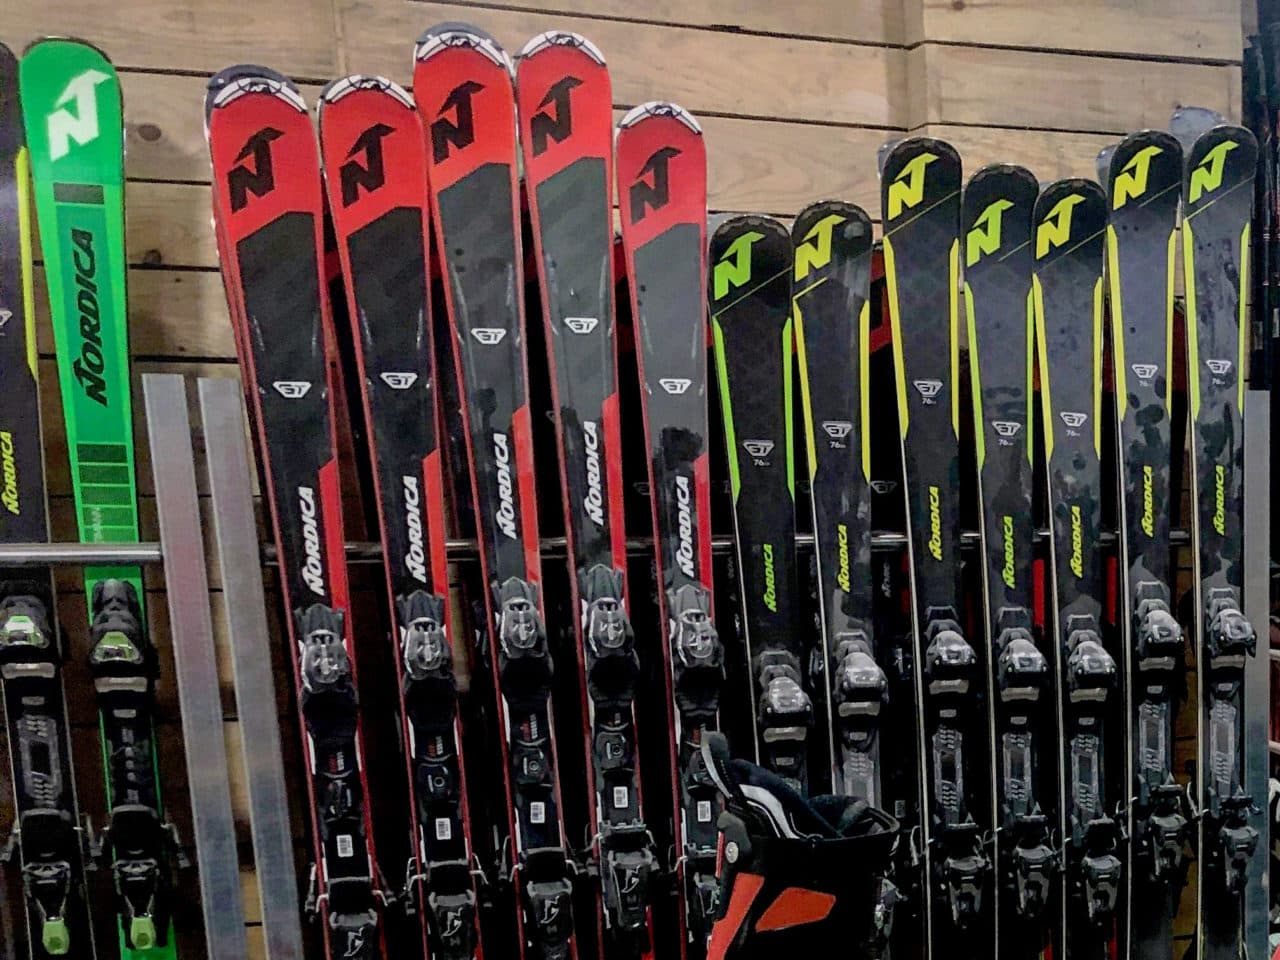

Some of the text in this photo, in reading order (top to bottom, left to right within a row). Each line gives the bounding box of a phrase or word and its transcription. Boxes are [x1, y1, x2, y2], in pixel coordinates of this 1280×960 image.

[73, 228, 108, 407] NORDICA
[0, 432, 20, 515] NORDICA
[493, 433, 517, 540] NORDICA
[585, 420, 605, 526] NORDICA
[1141, 466, 1154, 537] NORDICA
[1212, 465, 1226, 536] NORDICA
[301, 486, 325, 596] NORDICA
[404, 475, 426, 583] NORDICA
[676, 476, 694, 578] NORDICA
[836, 524, 850, 592] NORDICA
[928, 486, 942, 561] NORDICA
[1002, 516, 1016, 589] NORDICA
[1070, 505, 1083, 578] NORDICA
[764, 543, 777, 612] NORDICA
